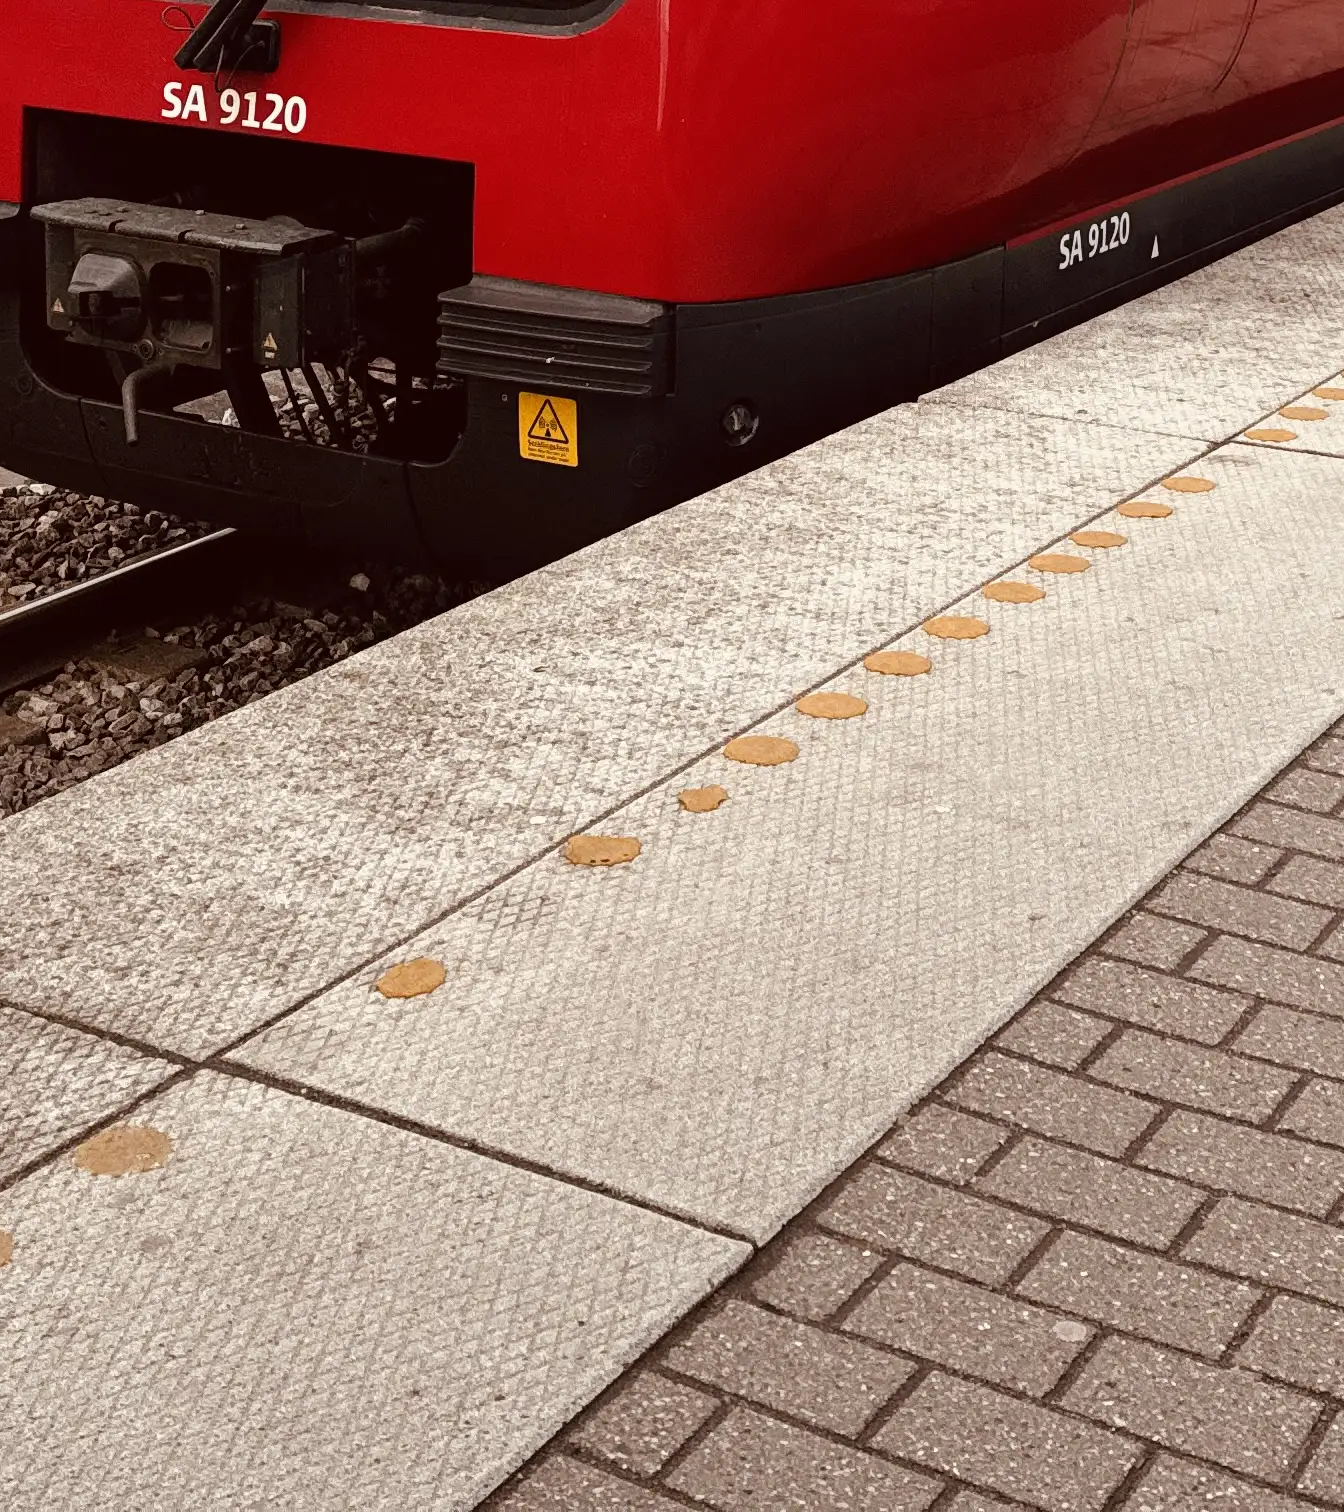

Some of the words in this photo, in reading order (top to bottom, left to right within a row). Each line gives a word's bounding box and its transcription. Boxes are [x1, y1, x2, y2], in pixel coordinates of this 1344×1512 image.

[161, 81, 207, 121] SA
[219, 88, 307, 133] 9120
[1059, 229, 1083, 270] SA
[1088, 211, 1130, 258] 9120
